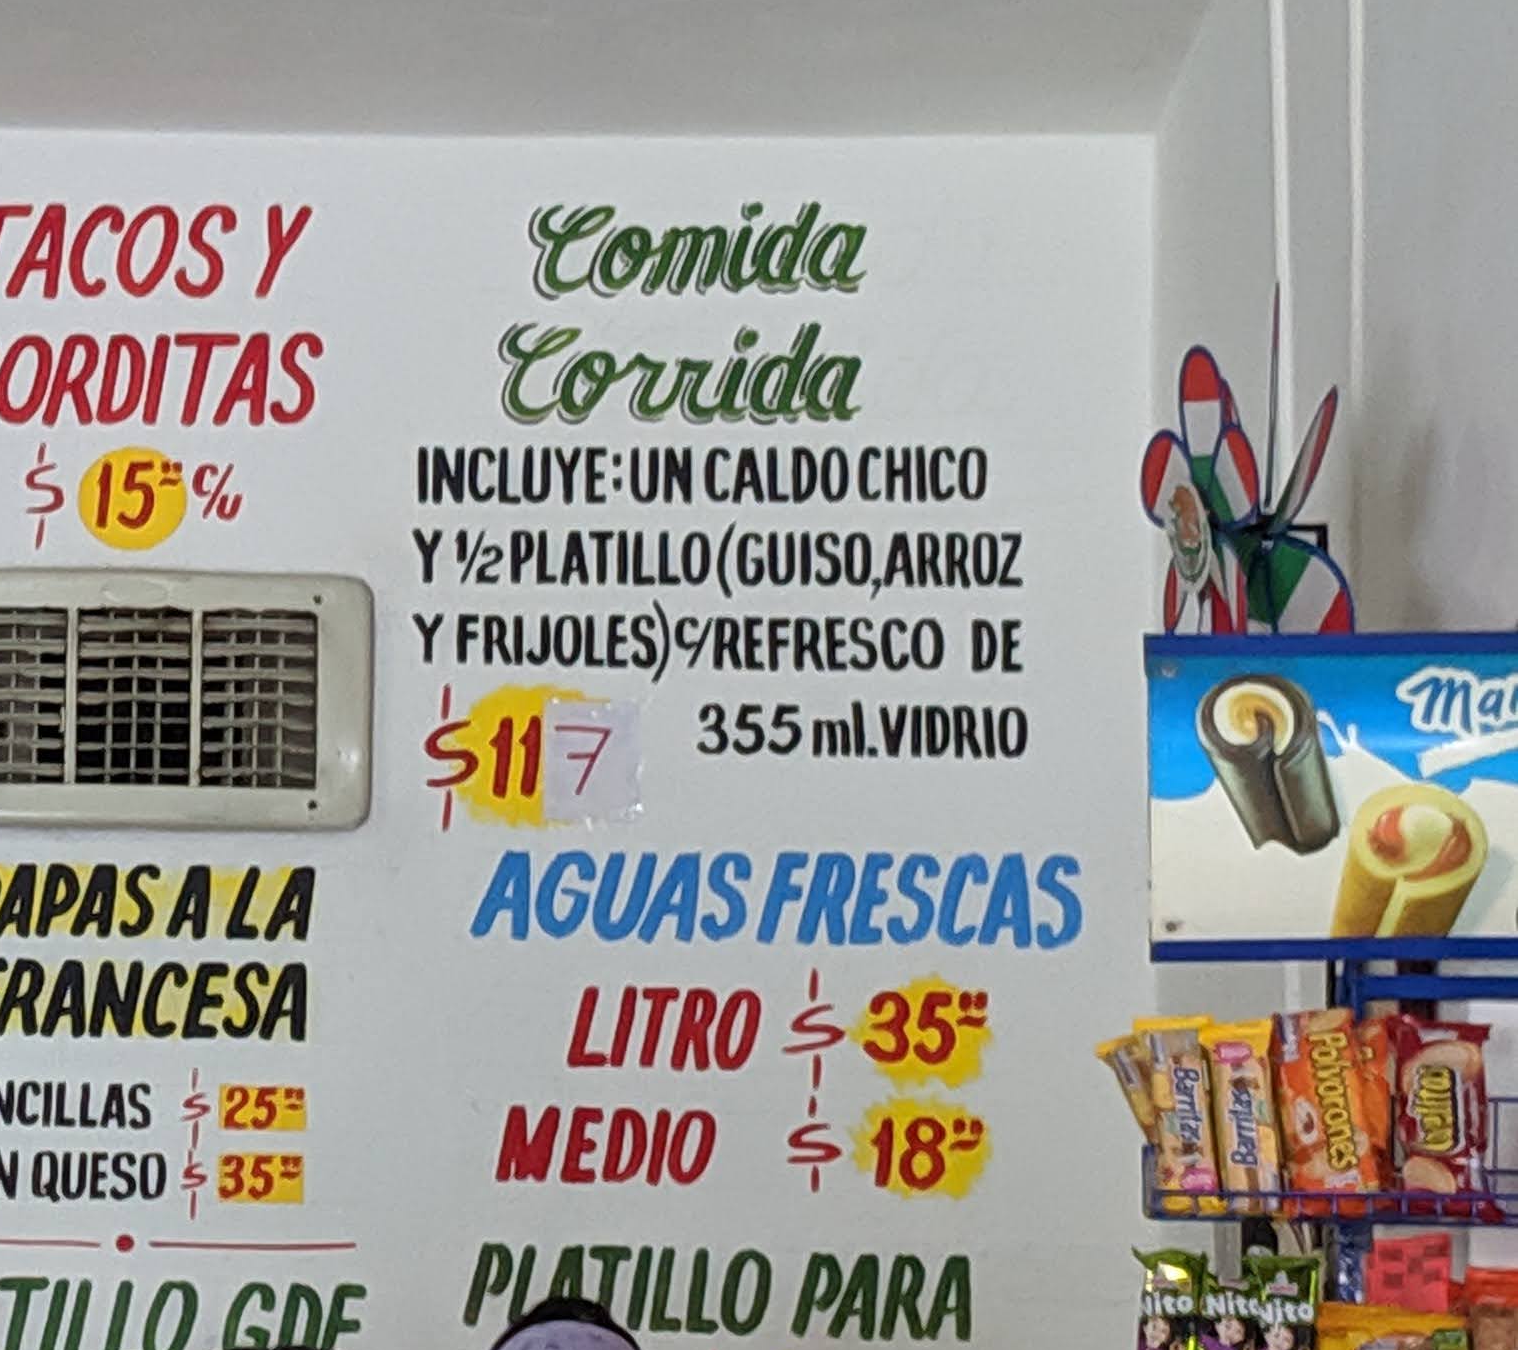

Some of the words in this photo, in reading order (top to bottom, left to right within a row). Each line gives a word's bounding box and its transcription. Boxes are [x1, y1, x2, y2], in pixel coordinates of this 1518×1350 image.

[255, 204, 313, 299] Y
[529, 201, 866, 299] Comida
[498, 322, 862, 425] Corrida
[704, 447, 848, 504] CALDO
[858, 448, 988, 503] CHICO
[413, 529, 443, 583] Y
[510, 531, 711, 586] PLATILLO
[413, 613, 443, 664] Y
[456, 600, 669, 684] FRIJOLES)
[972, 619, 1022, 673] DE
[697, 704, 801, 758] 355
[166, 864, 212, 939] A
[224, 866, 316, 942] LA
[470, 849, 752, 942] AGUAS
[757, 852, 1083, 950] FRESCAS
[566, 986, 762, 1071] LITRO
[31, 1151, 167, 1203] QUESO
[495, 1105, 716, 1185] MEDIO
[463, 1242, 771, 1335] PLATILLO
[791, 1252, 971, 1340] PARA
